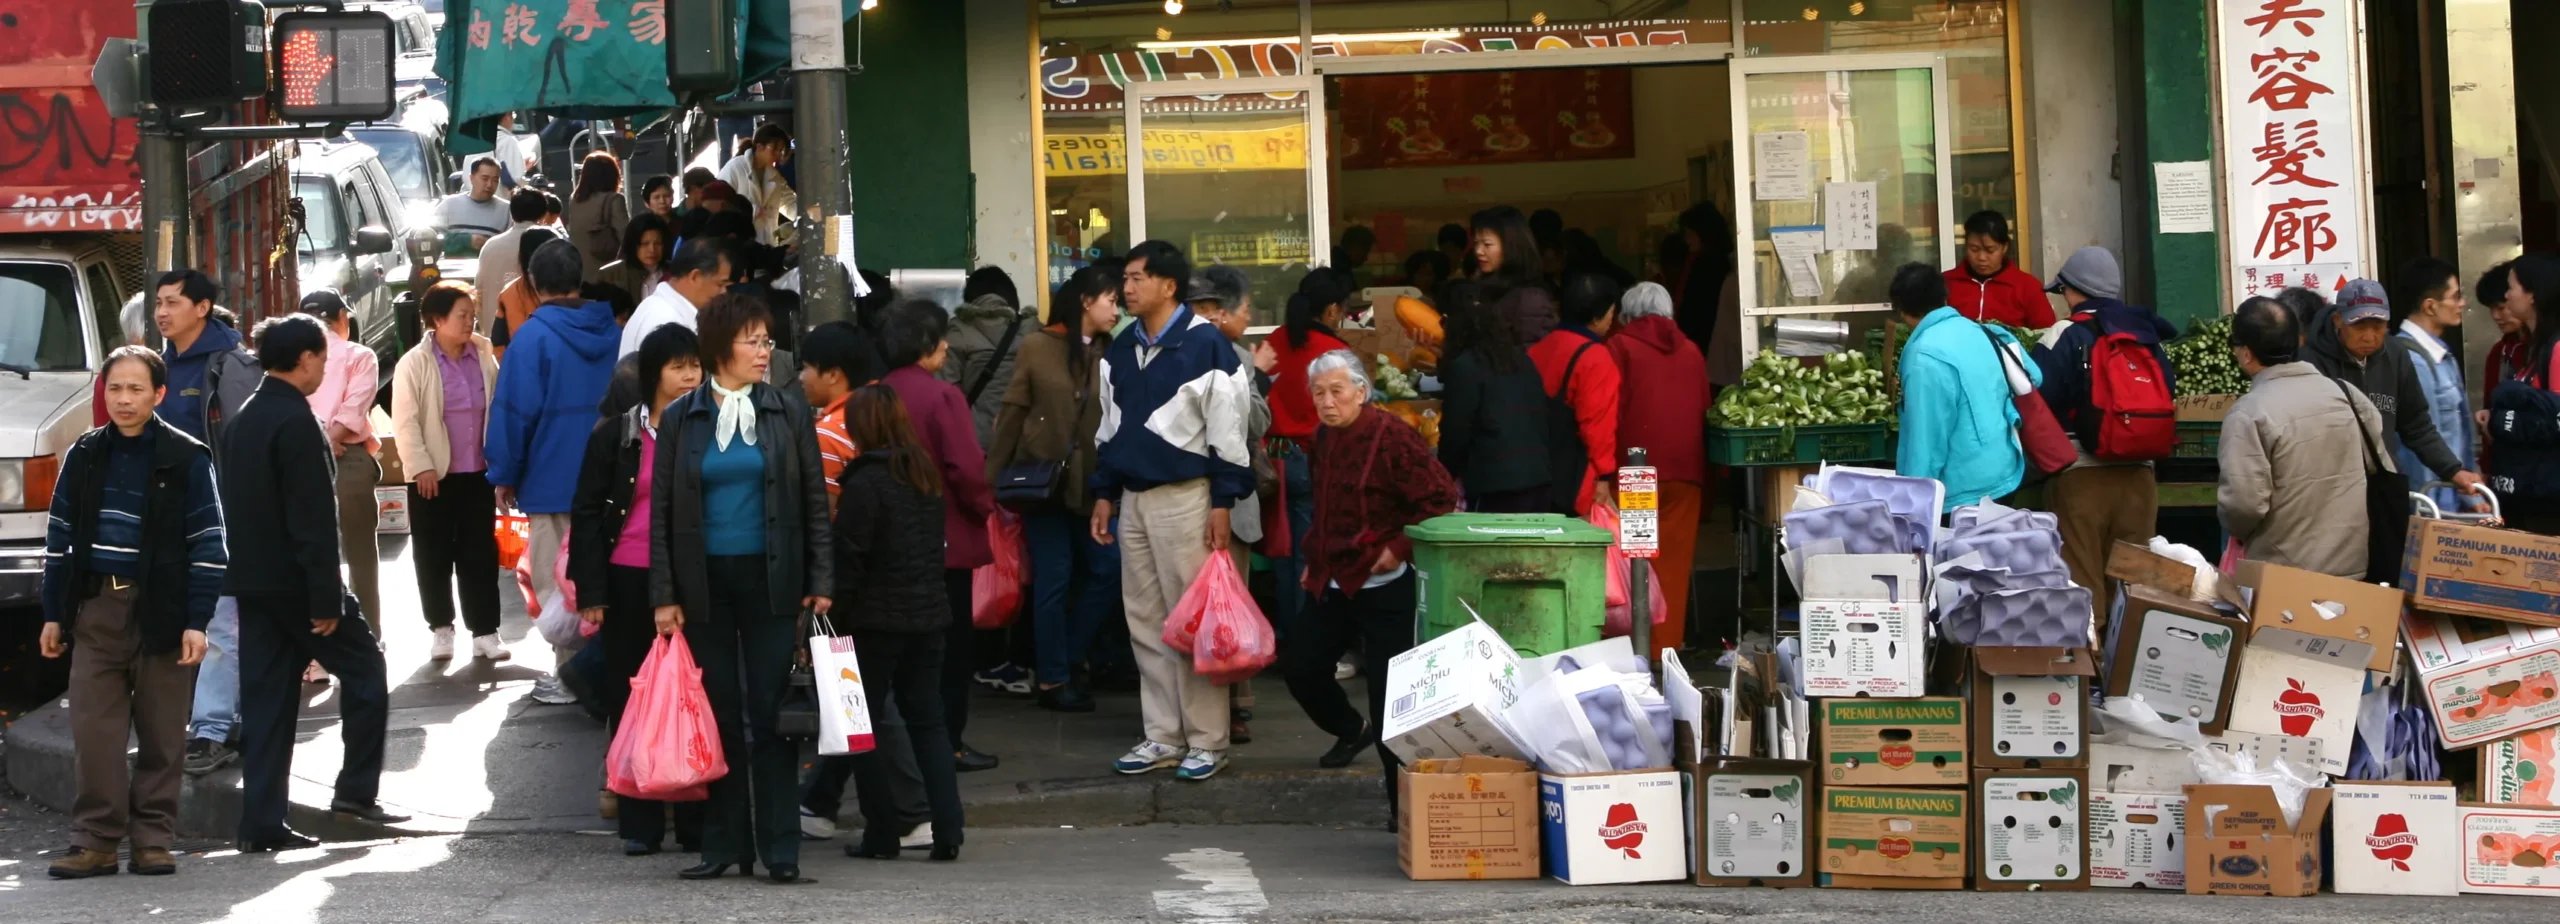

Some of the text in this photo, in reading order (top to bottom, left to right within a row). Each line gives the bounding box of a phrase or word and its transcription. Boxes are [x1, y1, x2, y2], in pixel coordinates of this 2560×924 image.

[2437, 535, 2560, 561] PREMIUM BANANA
[2440, 549, 2468, 559] CORITA
[2433, 556, 2473, 567] BANANAS
[1835, 707, 1954, 720] PREMIUM BANANAS
[2273, 701, 2325, 718] WASHINGTON
[1893, 751, 1913, 759] Monte
[1835, 795, 1954, 812] PREMIUM BANANAS
[1598, 823, 1648, 838] WASHINGTON
[1880, 842, 1911, 851] Del Monte
[2365, 834, 2419, 849] WASHINGTON
